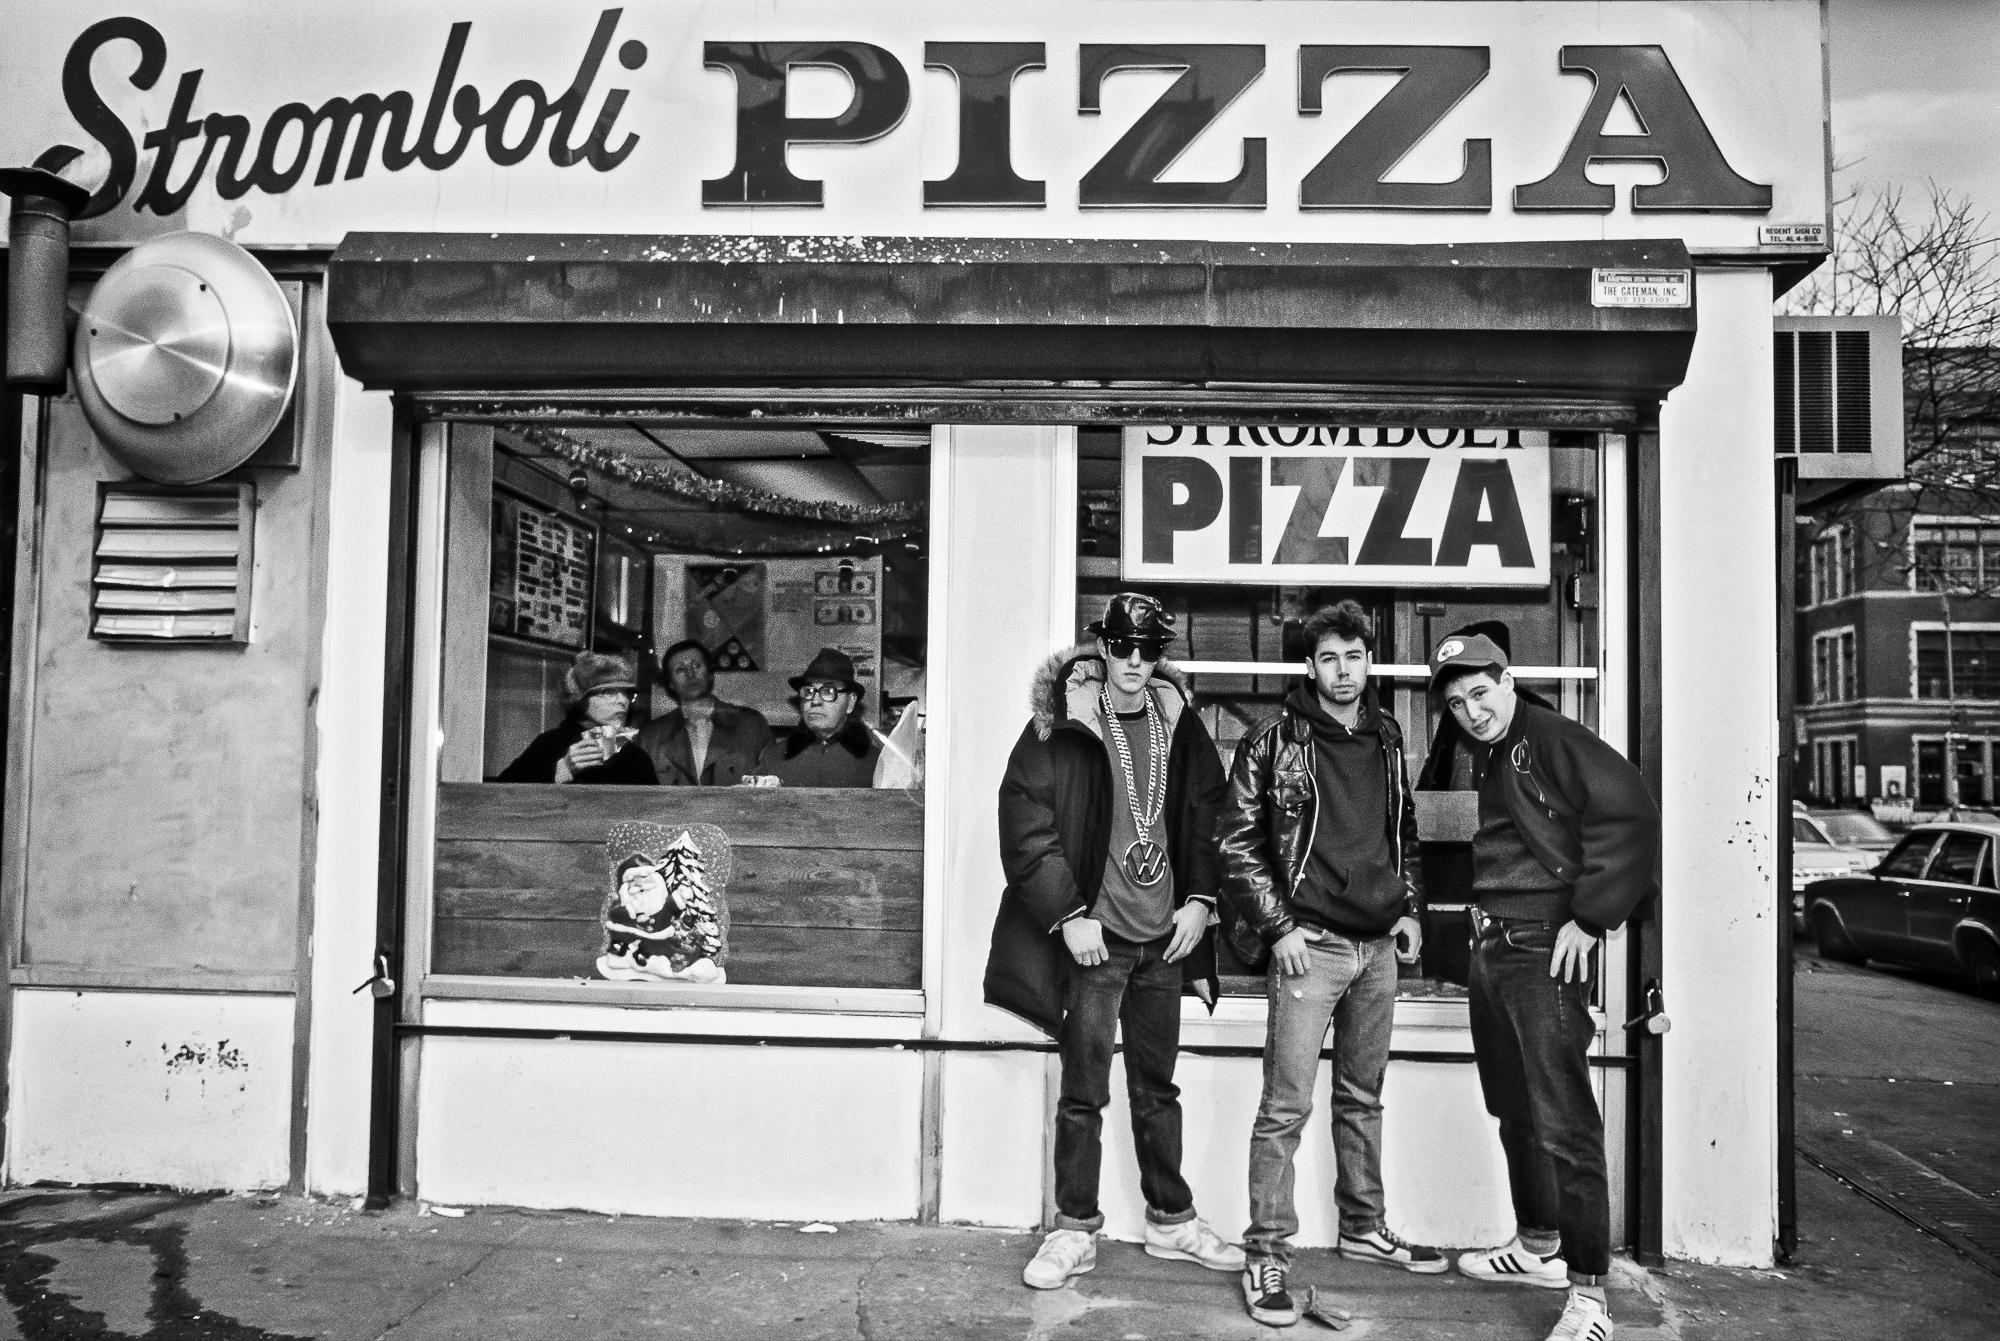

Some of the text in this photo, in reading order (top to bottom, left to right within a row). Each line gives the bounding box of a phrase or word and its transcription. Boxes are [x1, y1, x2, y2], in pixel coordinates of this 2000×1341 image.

[33, 8, 1773, 219] Stromboli PIZZA
[1603, 286, 1617, 296] THE
[1142, 456, 1536, 568] PIZZA
